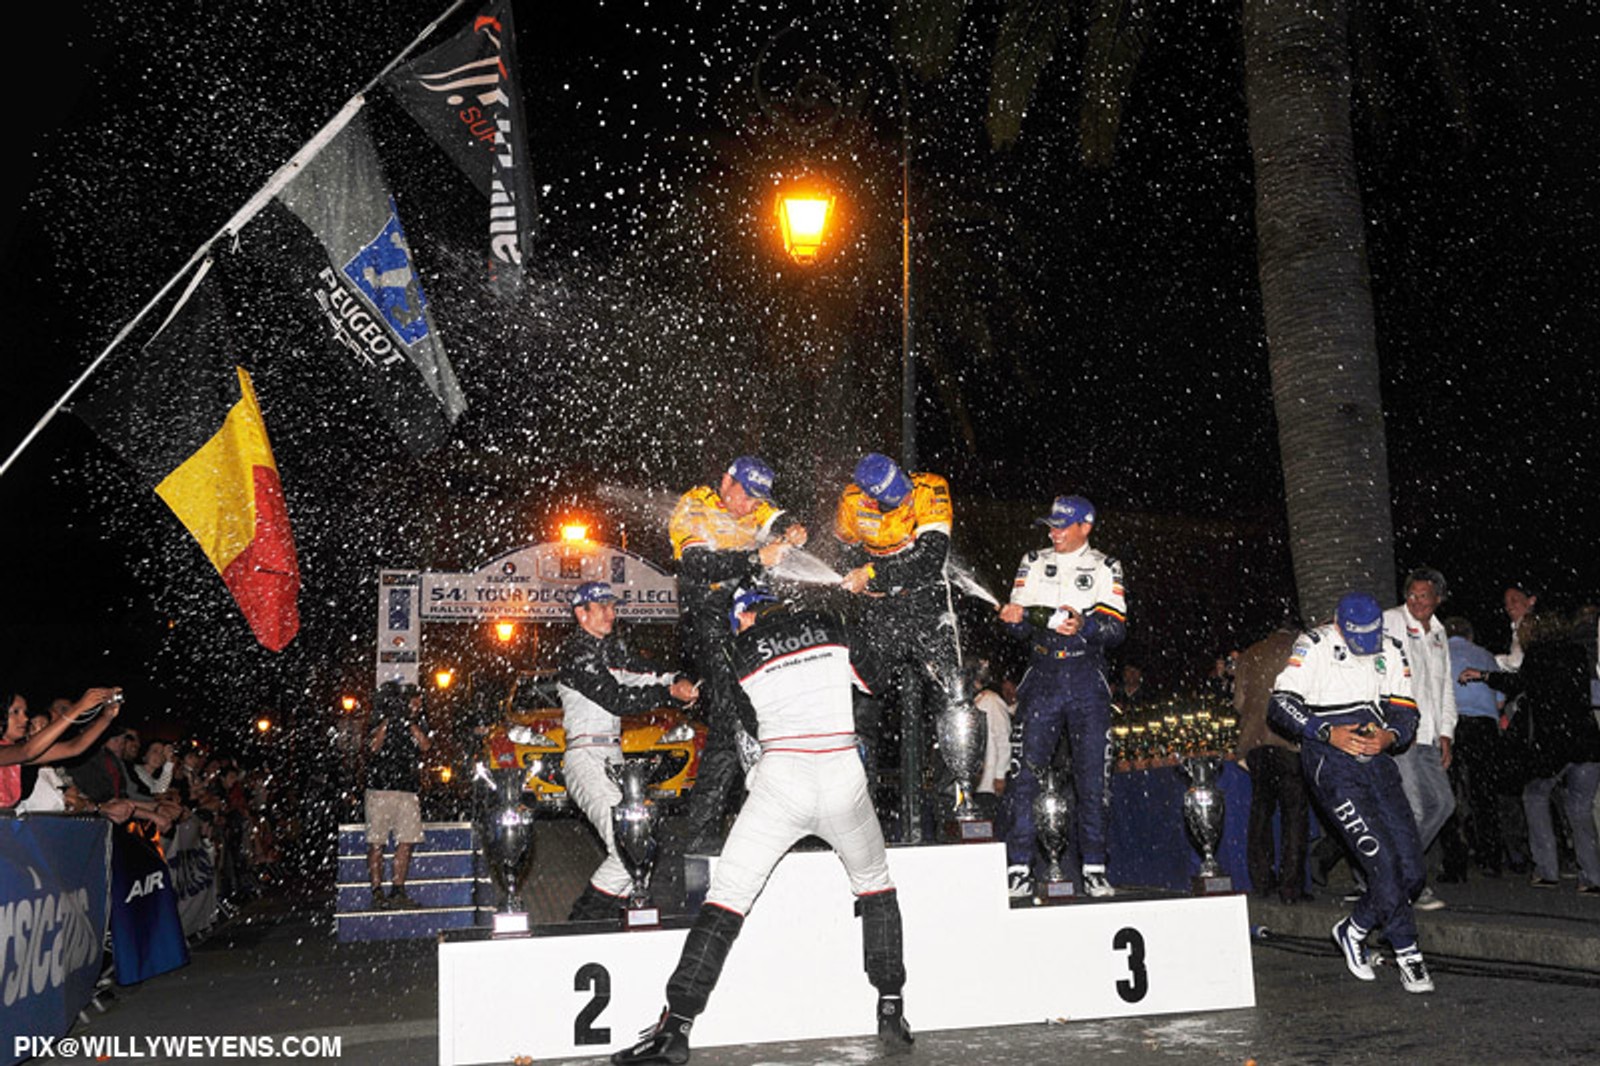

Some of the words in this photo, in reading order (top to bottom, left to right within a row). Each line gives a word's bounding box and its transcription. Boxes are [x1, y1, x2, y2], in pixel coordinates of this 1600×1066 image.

[319, 266, 405, 364] PEUGEOT
[475, 588, 523, 602] TOUR
[757, 626, 829, 660] Škoda
[1333, 798, 1380, 857] BFO
[125, 870, 165, 904] AIR
[1112, 926, 1149, 1003] 3
[573, 962, 611, 1046] 2
